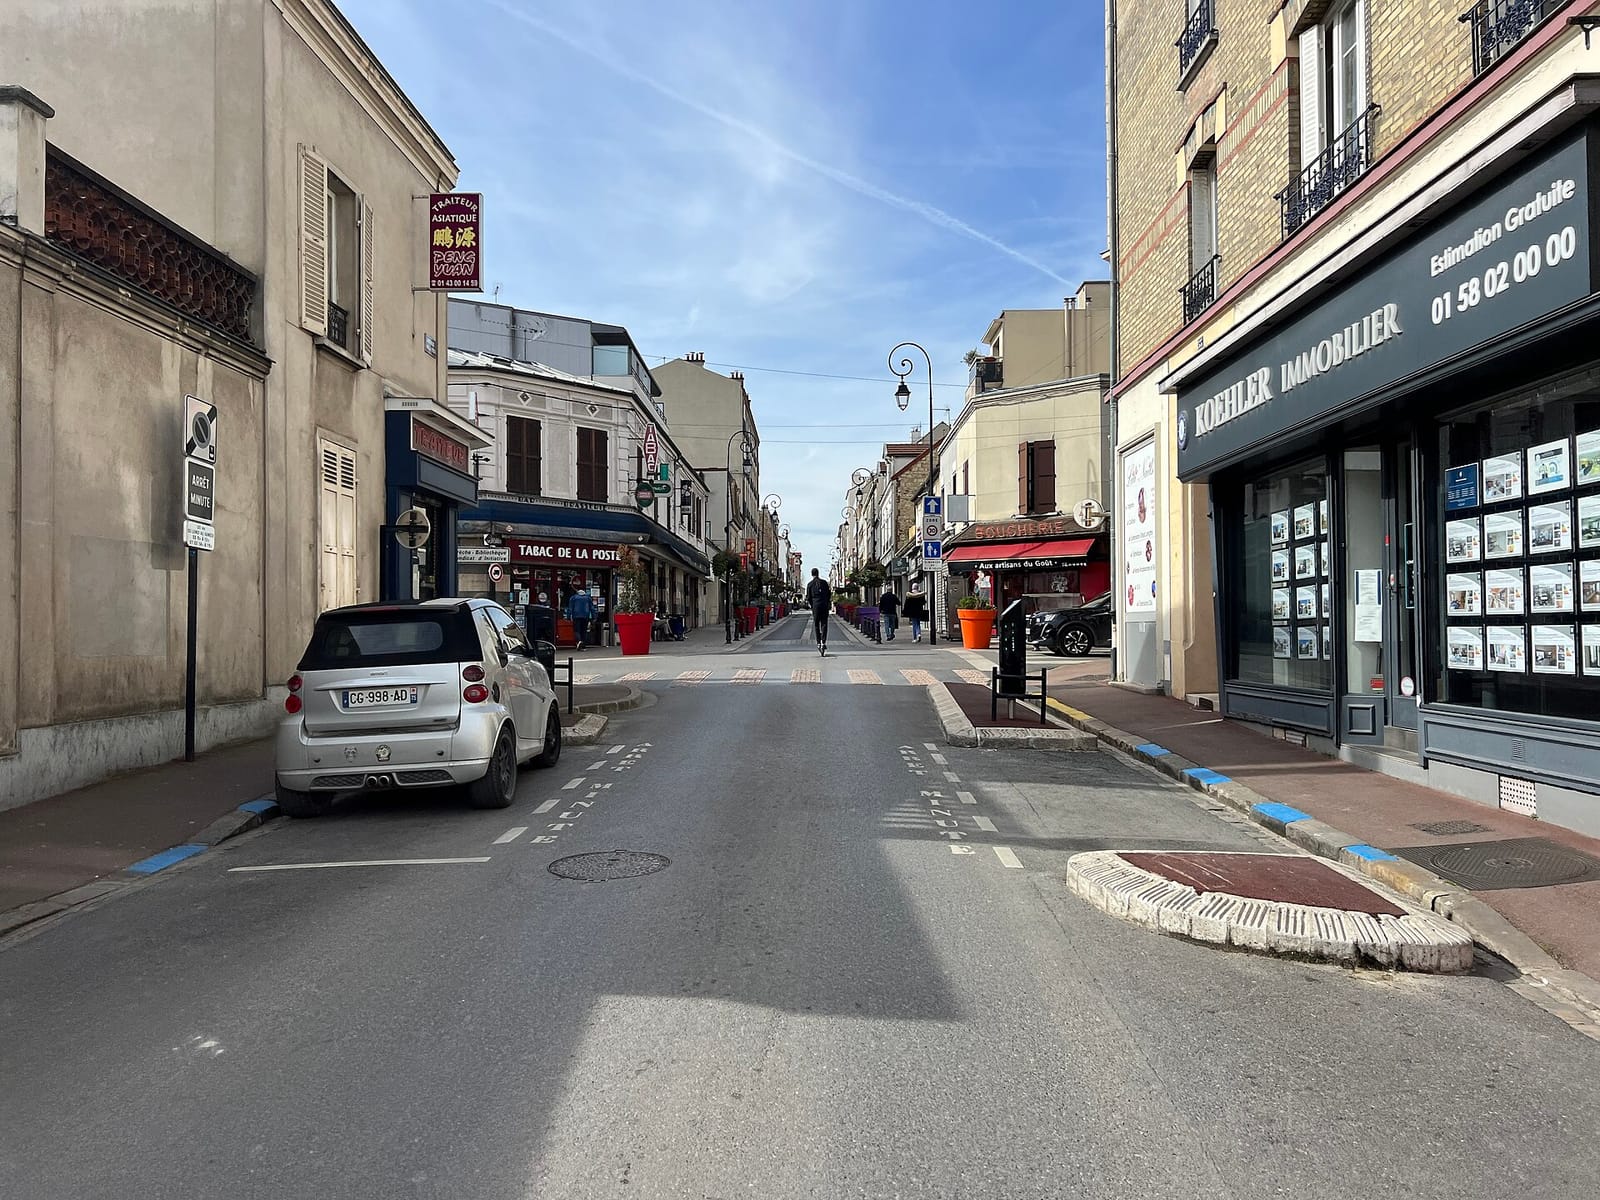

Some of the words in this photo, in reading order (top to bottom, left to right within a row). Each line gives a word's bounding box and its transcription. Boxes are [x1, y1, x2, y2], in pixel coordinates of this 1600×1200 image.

[431, 196, 478, 213] TRAITEUR
[431, 214, 478, 223] ASIATIQUE
[1430, 222, 1502, 278] Estimation
[1504, 179, 1576, 232] Gratuite
[433, 250, 476, 264] PENG
[433, 263, 475, 277] YUAN
[1431, 291, 1451, 325] 01
[1457, 277, 1481, 312] 58
[1484, 261, 1510, 298] 02
[1513, 244, 1541, 283] 00
[1546, 226, 1576, 266] 00
[1194, 366, 1273, 437] KOEHLER
[1280, 302, 1403, 393] IMMOBILIER
[645, 425, 657, 472] TABAC
[191, 474, 210, 489] ARRÊT
[190, 492, 210, 509] MINUTE
[975, 521, 1065, 539] BOUCHERIE
[518, 544, 553, 558] TABAC
[557, 547, 572, 559] DE
[576, 549, 589, 560] LA
[995, 561, 1021, 569] artisans
[1035, 559, 1053, 567] Goût
[350, 689, 408, 704] CG-998-AD
